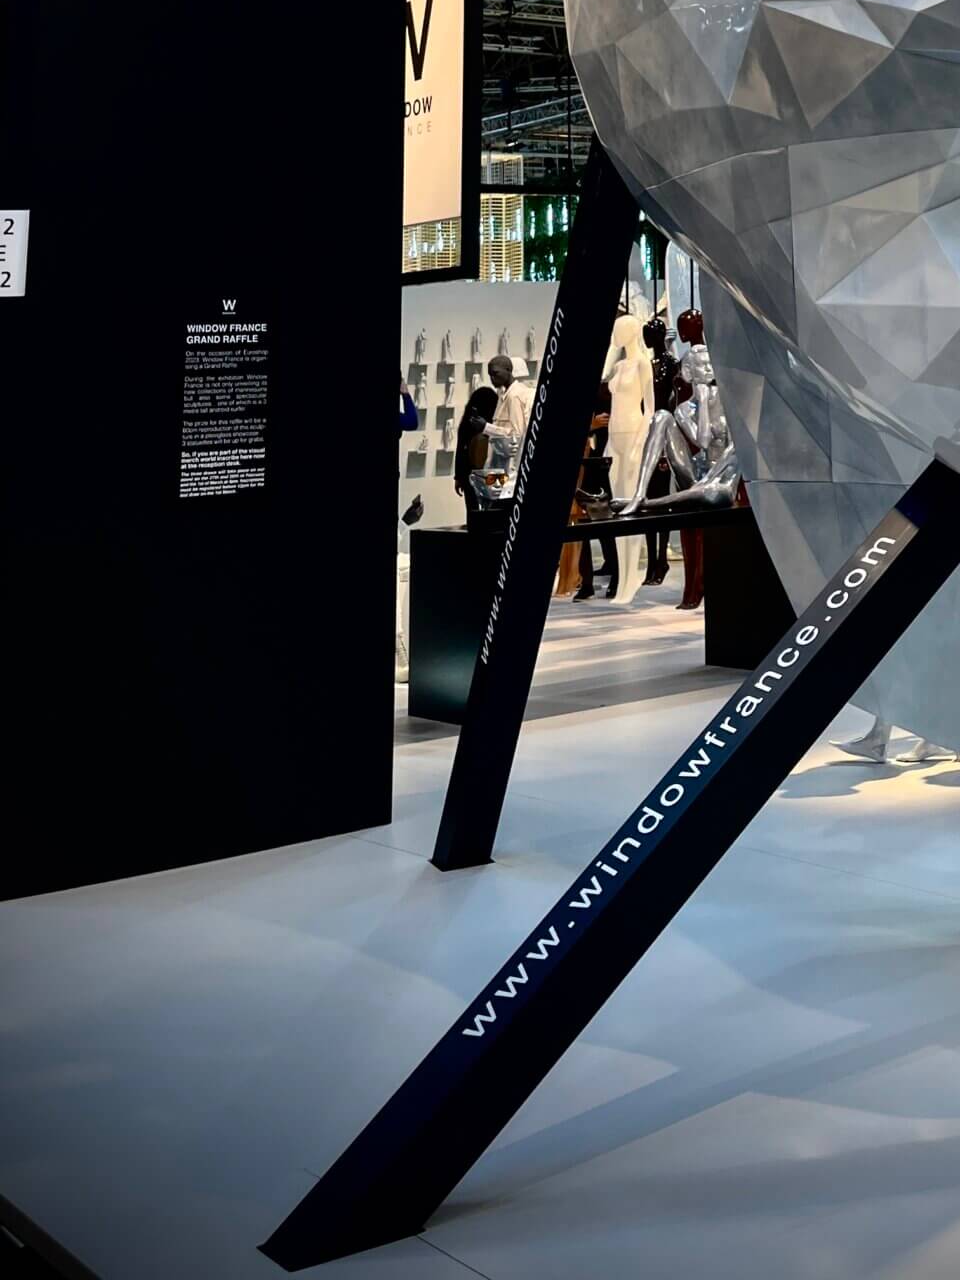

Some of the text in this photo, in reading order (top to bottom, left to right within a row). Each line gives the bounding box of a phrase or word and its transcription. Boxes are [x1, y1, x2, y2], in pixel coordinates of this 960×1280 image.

[222, 299, 237, 311] W
[187, 323, 267, 333] WINDOW FRANCE
[186, 334, 258, 344] GRAND RAFFLE
[480, 306, 565, 665] www.windowfrance.com
[462, 535, 896, 1039] www.windowfrance.com
